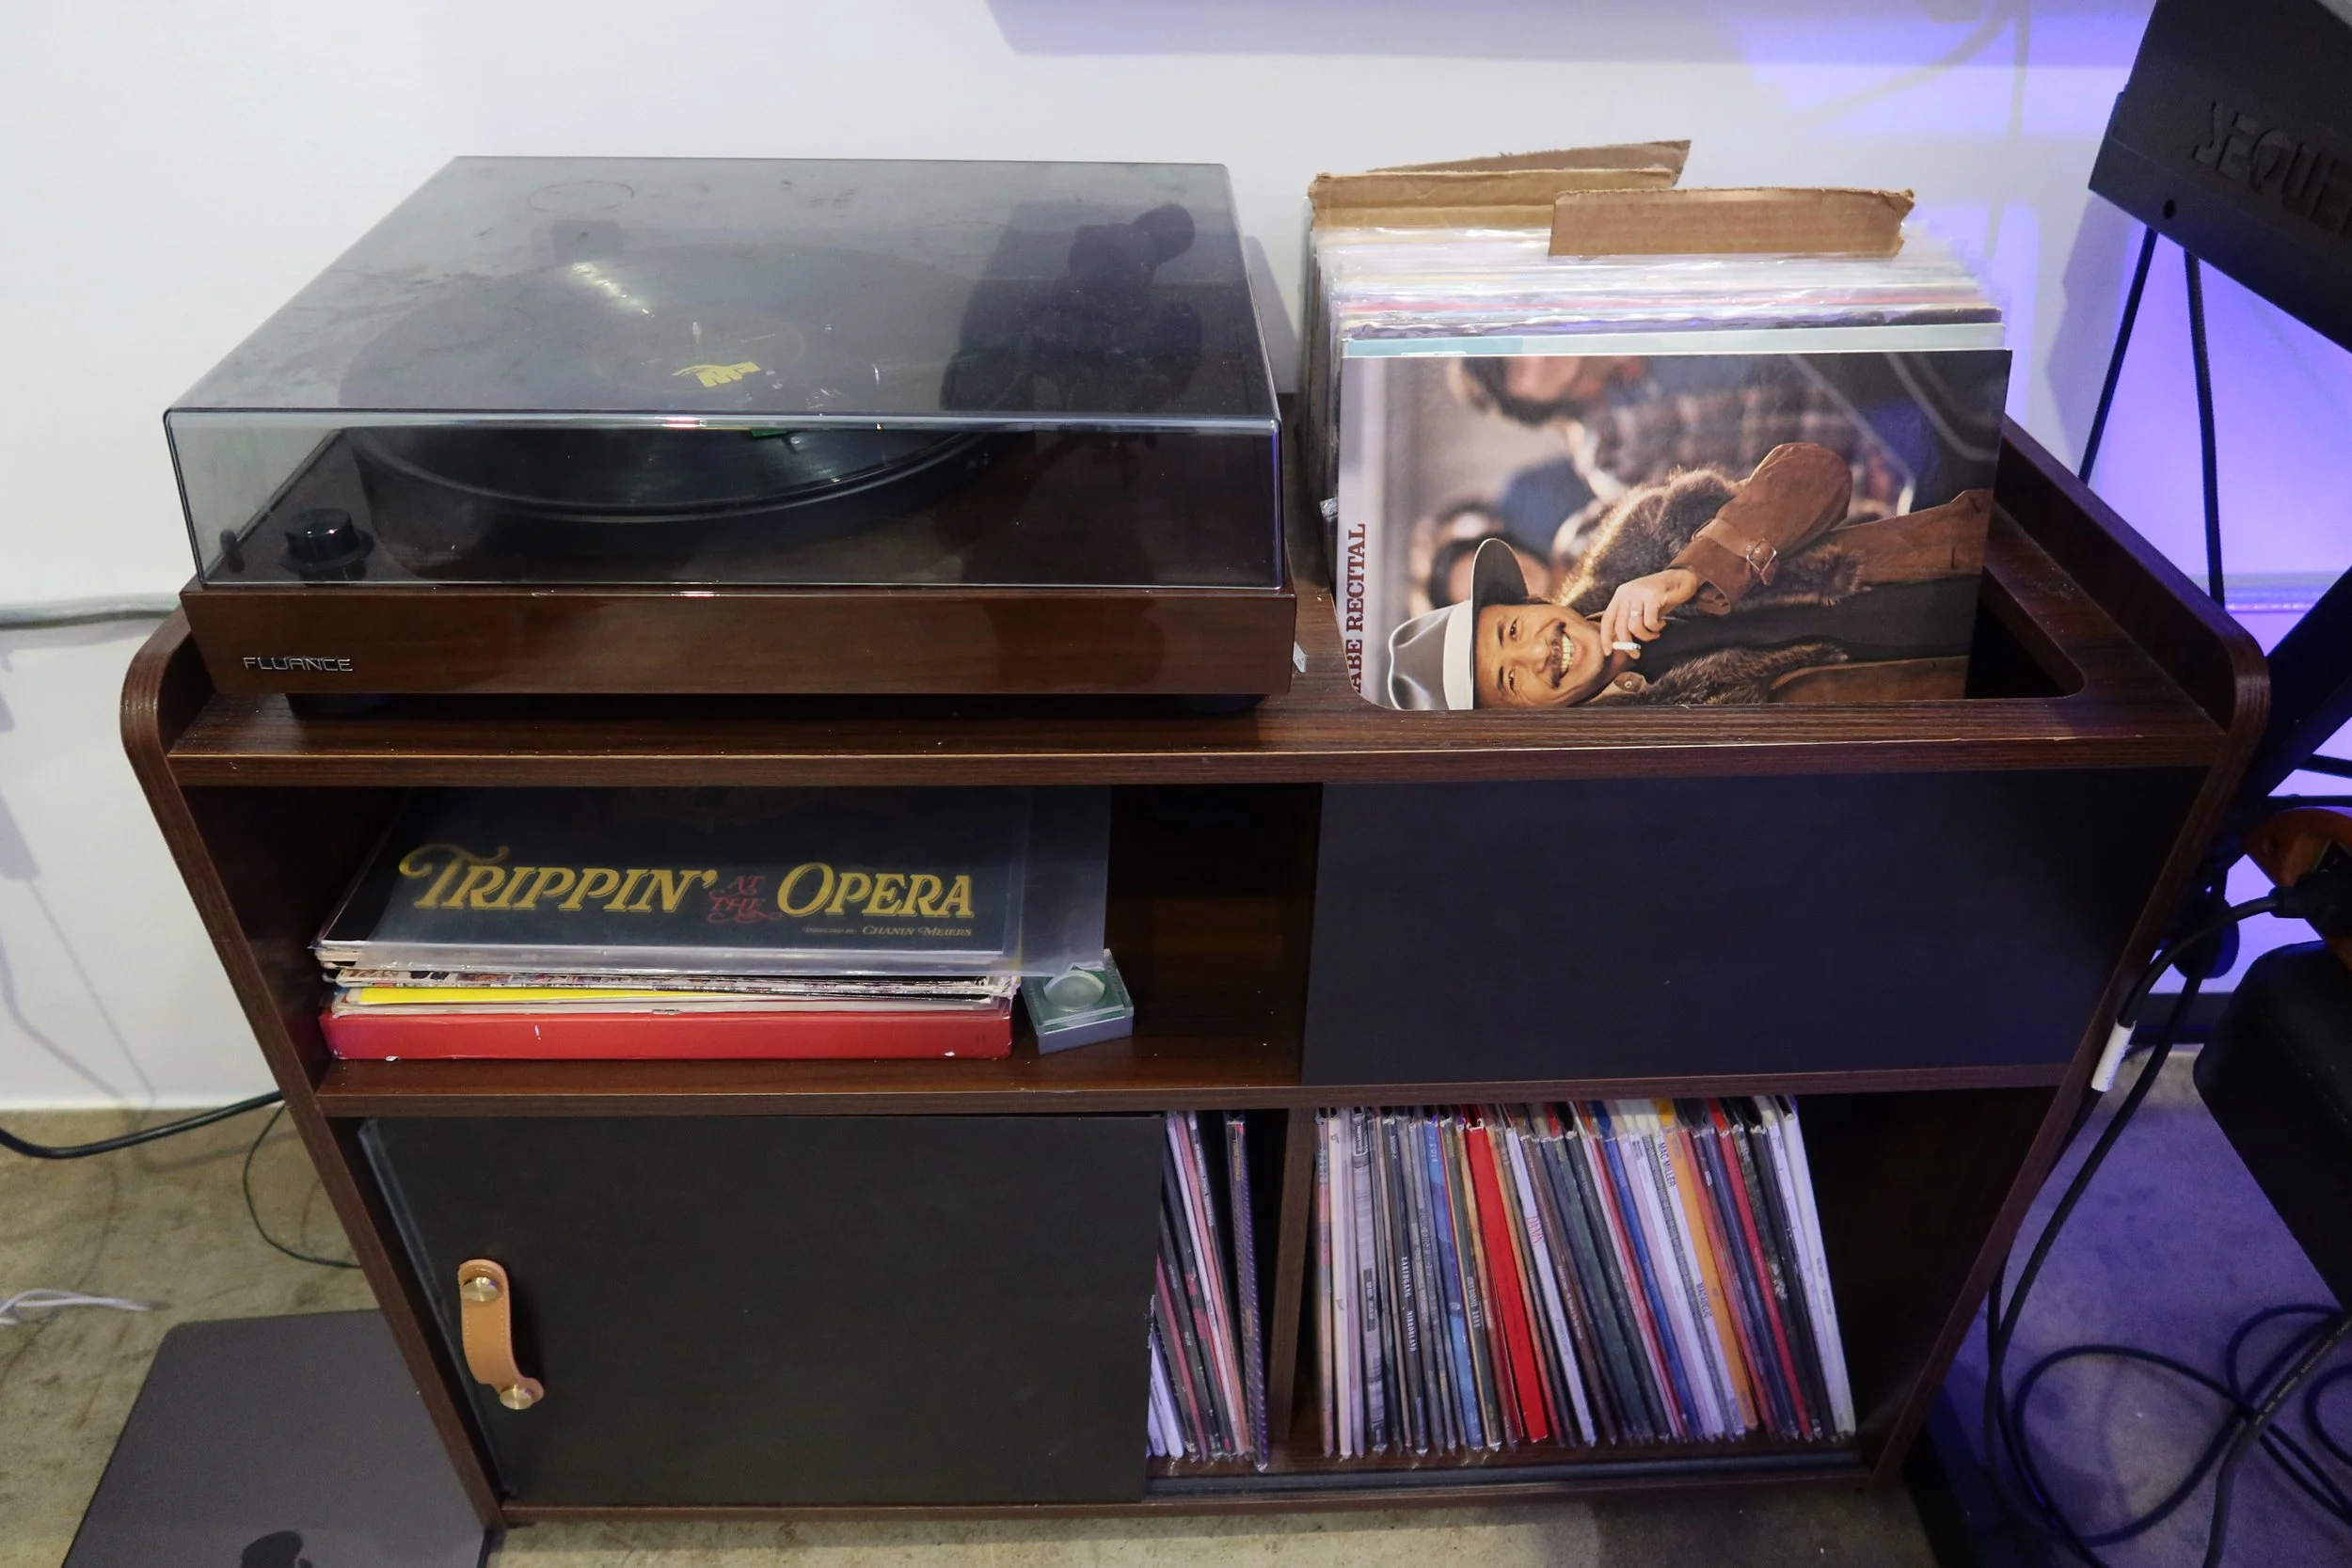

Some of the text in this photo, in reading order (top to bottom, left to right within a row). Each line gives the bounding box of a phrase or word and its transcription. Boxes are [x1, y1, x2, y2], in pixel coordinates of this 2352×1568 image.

[2190, 100, 2352, 240] SEQUE
[1346, 523, 1365, 632] RECITAL
[243, 656, 354, 672] FLUANCE
[399, 843, 719, 912] TRIPPIN'
[777, 862, 975, 919] OPERA
[1658, 1142, 1670, 1160] MAC
[1662, 1159, 1677, 1188] MILLER
[1401, 1256, 1418, 1352] EARTHGANG MIRRORLAND
